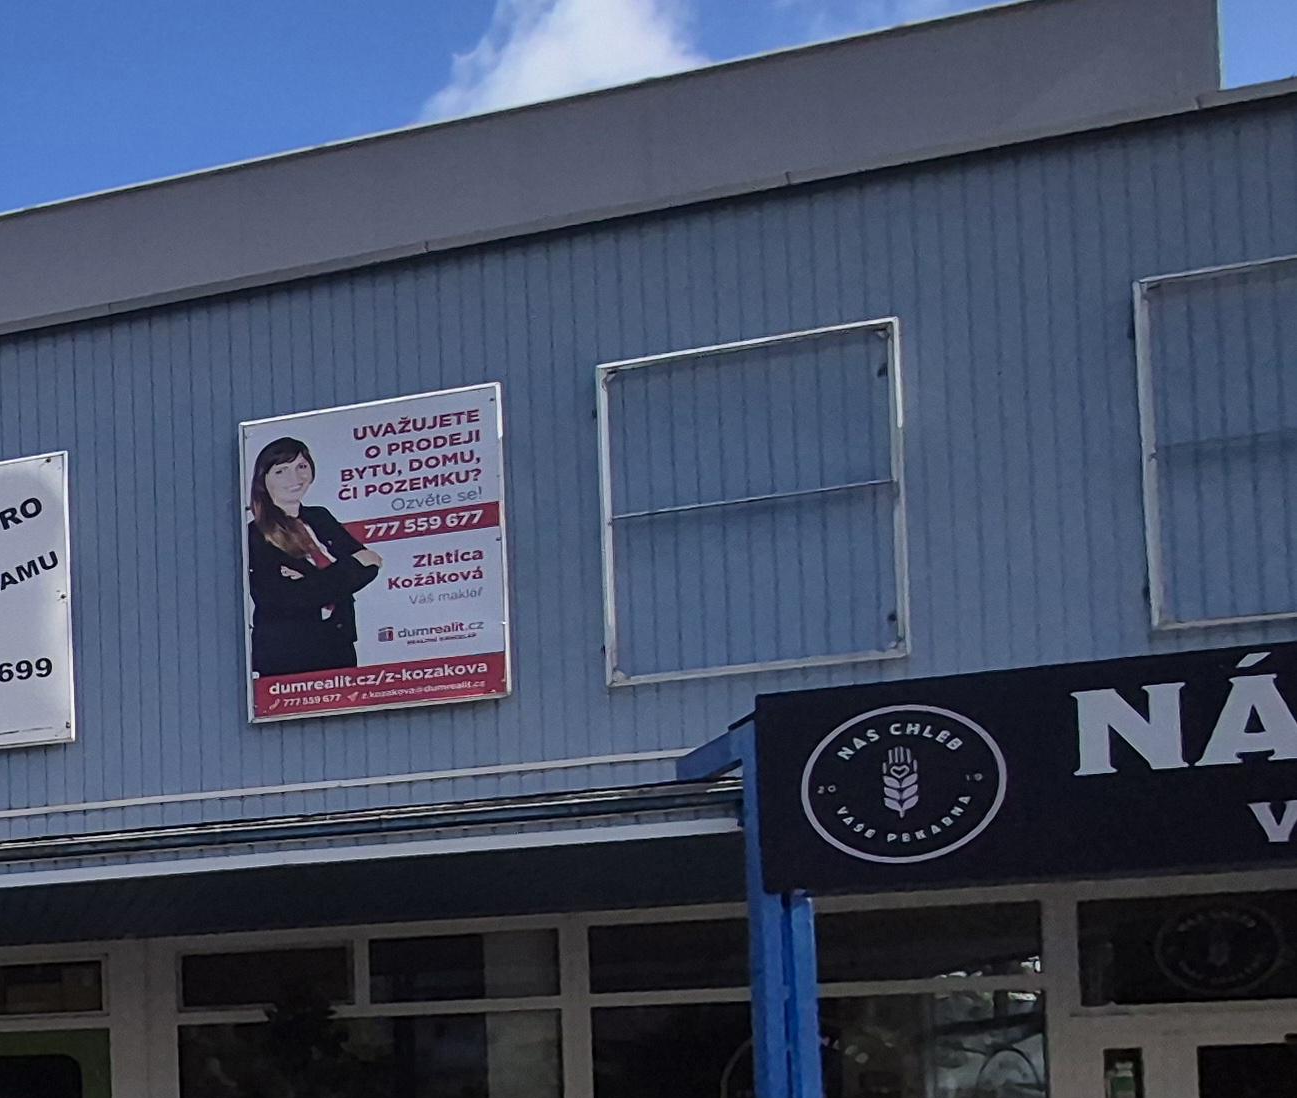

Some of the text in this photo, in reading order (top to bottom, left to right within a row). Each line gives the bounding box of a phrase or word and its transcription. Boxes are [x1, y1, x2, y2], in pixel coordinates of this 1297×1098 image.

[353, 409, 480, 441] UVAŽUJETE
[365, 429, 481, 459] O PRODEJI
[340, 450, 481, 482] BYTU, DOMU,
[338, 468, 482, 501] ČI POZEMKU?
[391, 486, 483, 511] Ozvěte se!
[364, 509, 483, 539] 777 559 677
[412, 549, 484, 568] Zlatica
[388, 565, 484, 590] Kožáková
[397, 621, 484, 638] dumrealit.cz
[269, 661, 488, 696] dumrealit.cz/z-kozakova
